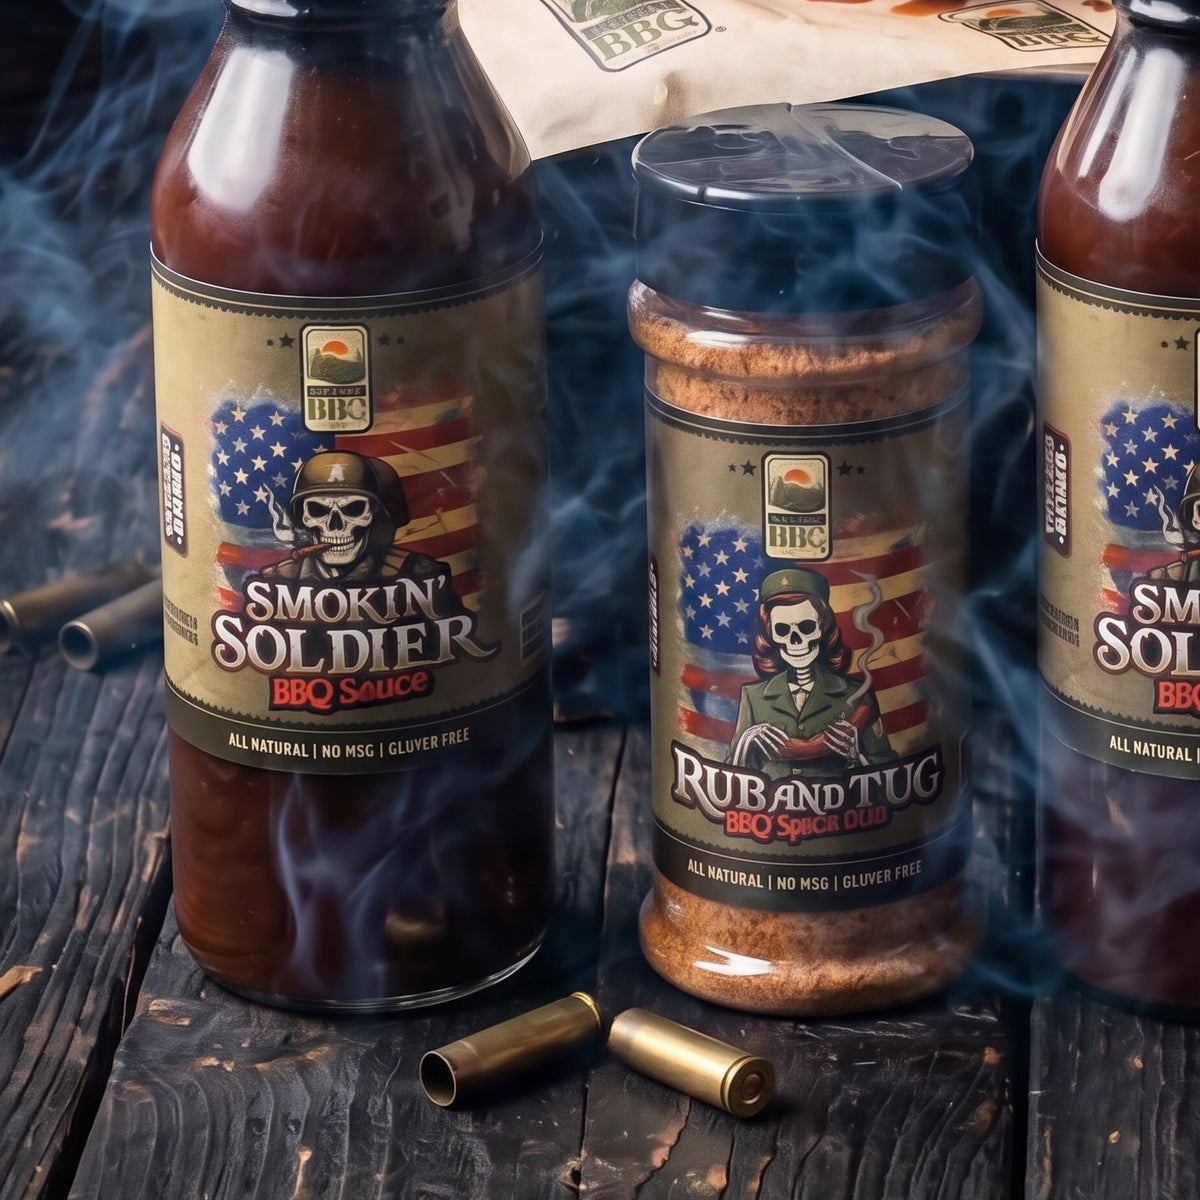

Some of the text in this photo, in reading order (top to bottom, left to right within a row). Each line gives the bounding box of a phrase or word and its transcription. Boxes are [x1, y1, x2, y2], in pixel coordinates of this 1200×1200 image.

[246, 574, 446, 625] SMOKIN'
[214, 614, 498, 675] SOLDIER
[272, 670, 430, 710] BBQ Sauce
[228, 732, 249, 750] ALL
[251, 737, 309, 758] NATURAL
[322, 744, 341, 759] NO
[345, 743, 374, 758] MSG
[442, 727, 470, 747] FREE
[1109, 735, 1131, 753] ALL
[1133, 740, 1193, 763] NATURAL
[673, 746, 941, 819] RUB AND TUG
[687, 858, 706, 877] ALL
[708, 866, 764, 888] NATURAL
[777, 876, 796, 890] NO
[800, 876, 829, 891] MSG
[895, 859, 922, 880] FREE
